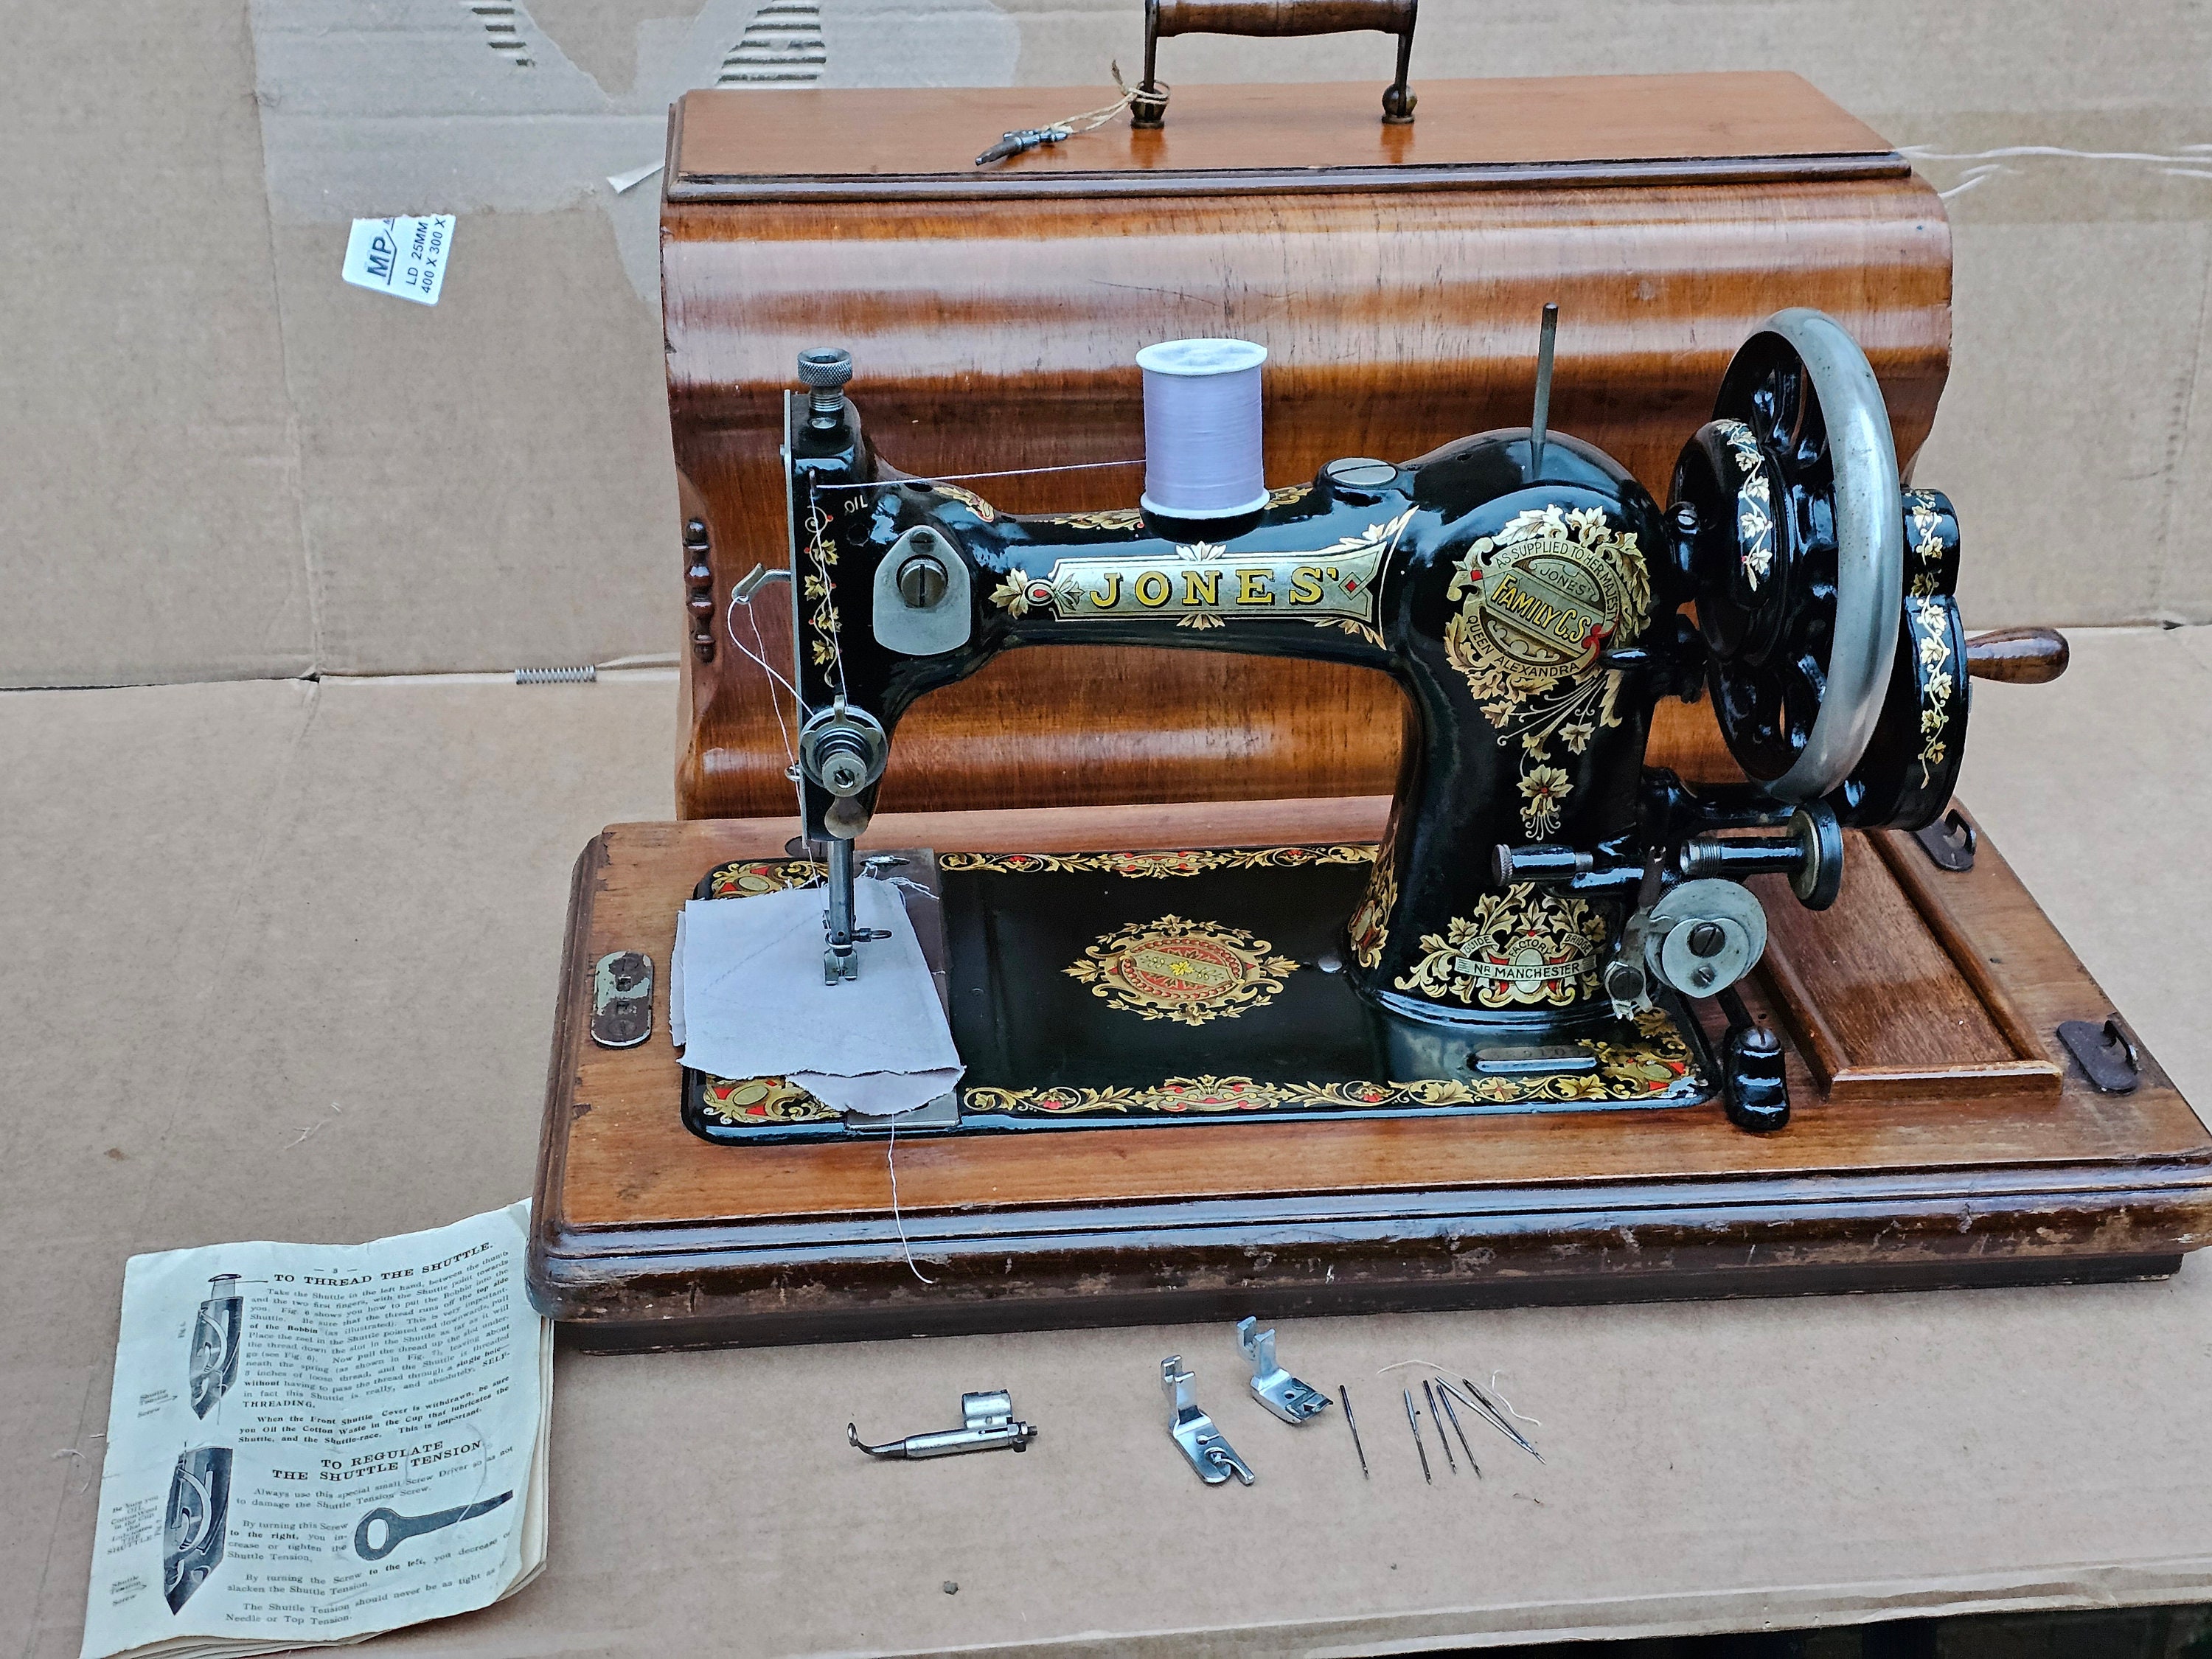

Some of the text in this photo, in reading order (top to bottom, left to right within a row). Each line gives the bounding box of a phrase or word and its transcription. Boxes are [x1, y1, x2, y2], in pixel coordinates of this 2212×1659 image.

[367, 236, 392, 277] MP
[406, 222, 428, 285] LD 25MM
[421, 218, 446, 293] 400 X 300 X
[844, 495, 868, 513] OIL
[1089, 567, 1338, 608] JONES'
[1495, 542, 1618, 622] AS SUPPLIED TO HER MAJESTY
[1492, 574, 1561, 627] FAMILY
[1466, 615, 1579, 676] QUEEN ALEXANDRA
[1464, 936, 1489, 953] GUIDE
[1509, 939, 1552, 957] FACTORY
[1565, 934, 1590, 953] BRIDGE
[1495, 963, 1579, 978] MANCHESTER
[304, 1276, 372, 1286] THREAD
[380, 1269, 414, 1280] THE
[422, 1242, 493, 1273] SHUTTLE.
[416, 1285, 448, 1295] Shuttle
[452, 1275, 472, 1287] point
[477, 1260, 509, 1276] towards
[429, 1270, 462, 1285] between
[467, 1263, 479, 1271] the
[477, 1277, 509, 1294] top side
[457, 1355, 481, 1368] single
[338, 1425, 366, 1435] Waste
[451, 1394, 491, 1412] lubricates
[497, 1386, 509, 1394] the
[341, 1414, 373, 1425] Shuttle
[382, 1408, 408, 1416] Cover
[425, 1391, 474, 1409] withdrawn,
[493, 1377, 509, 1386] sure
[437, 1409, 481, 1426] important.
[273, 1439, 481, 1481] THE SHUTTLE TENSION
[321, 1441, 442, 1469] TO REGULATE
[254, 1488, 289, 1498] Always
[338, 1484, 370, 1499] special
[375, 1481, 400, 1490] small
[406, 1475, 434, 1486] Screw
[439, 1464, 468, 1477] Driver
[252, 1499, 290, 1509] damage
[317, 1501, 352, 1509] Shuttle
[357, 1492, 394, 1504] Tension
[400, 1486, 431, 1496] Screw.
[259, 1522, 295, 1530] turning
[320, 1523, 348, 1531] Screw
[228, 1551, 264, 1559] Shuttle
[245, 1574, 258, 1582] By
[333, 1572, 362, 1584] Screw
[434, 1553, 451, 1563] you
[459, 1539, 498, 1556] decrease
[288, 1544, 321, 1552] tighten
[268, 1604, 305, 1612] Shuttle
[311, 1604, 349, 1614] Tension
[355, 1593, 388, 1606] should
[394, 1588, 420, 1599] never
[459, 1573, 480, 1585] tight
[290, 1587, 325, 1596] Shuttle
[226, 1613, 261, 1621] Needle
[284, 1615, 305, 1624] Top
[310, 1615, 352, 1625] Tension.
